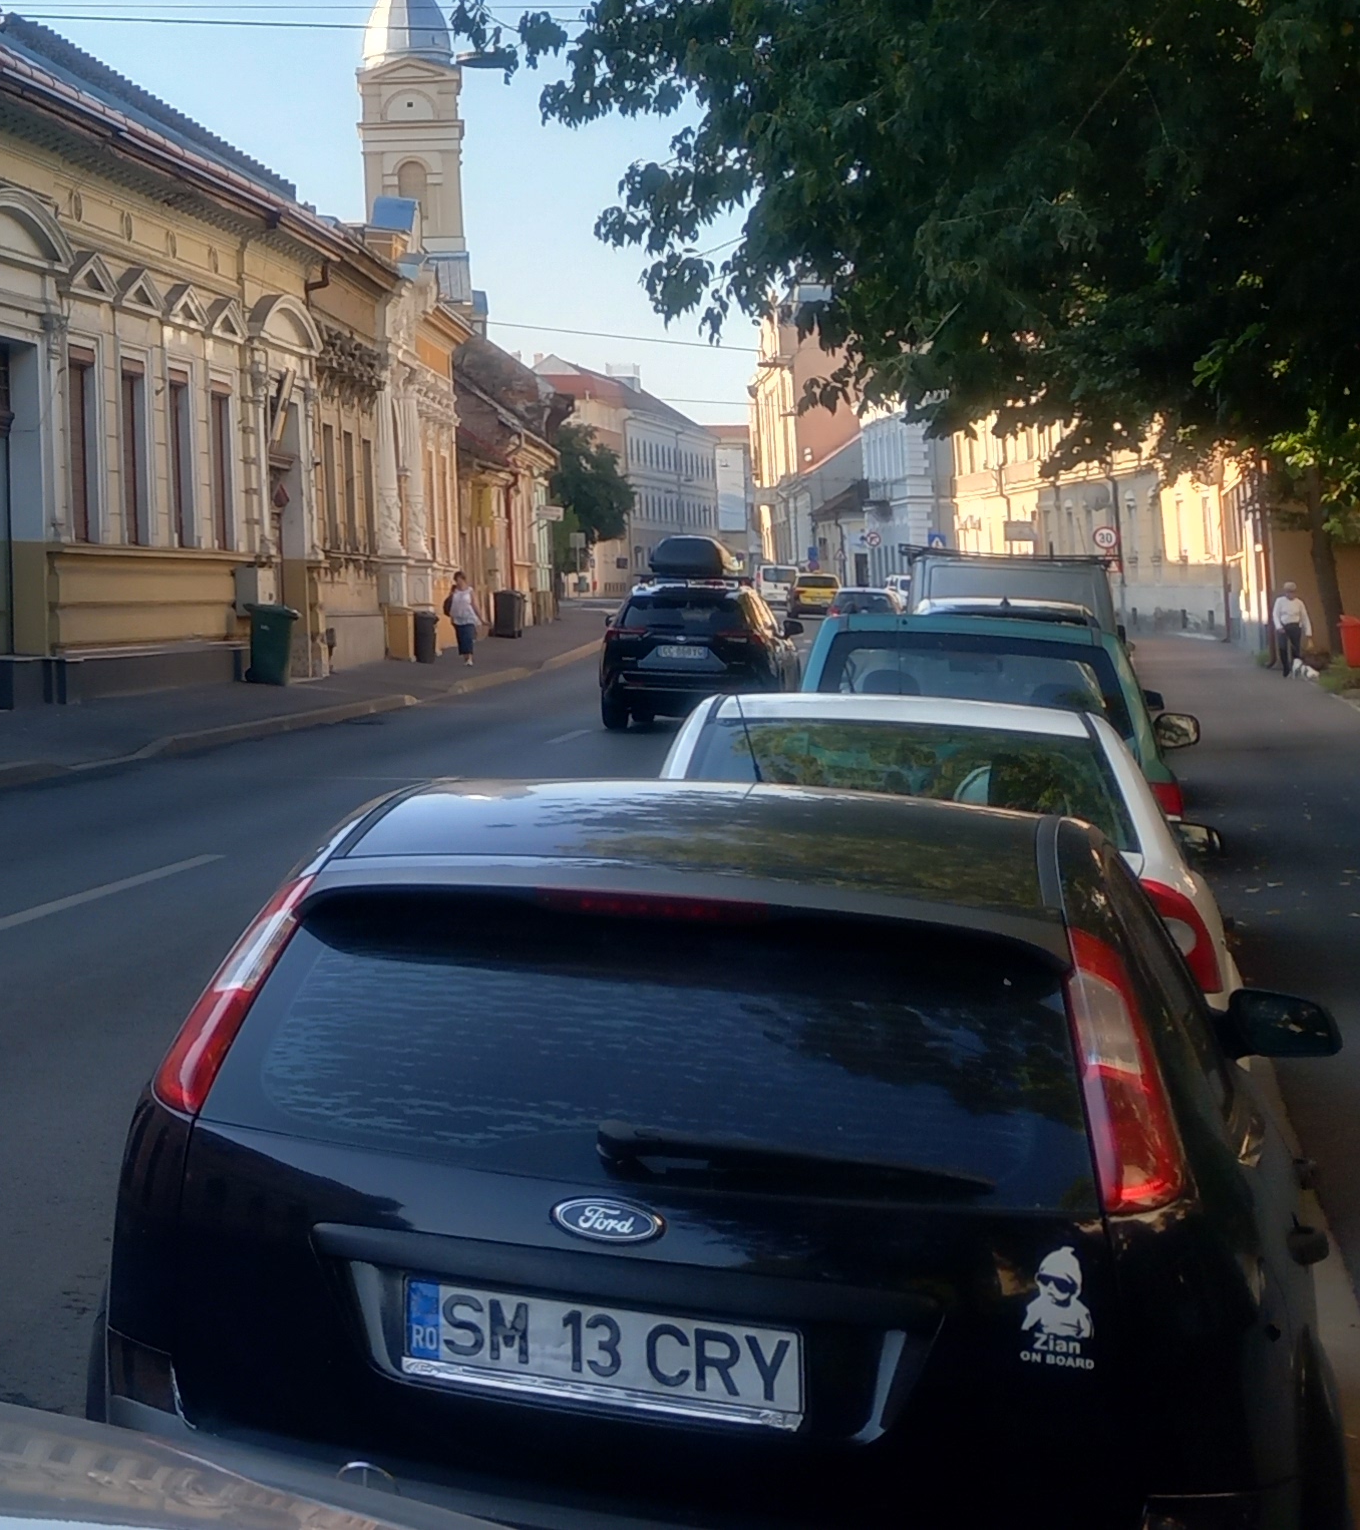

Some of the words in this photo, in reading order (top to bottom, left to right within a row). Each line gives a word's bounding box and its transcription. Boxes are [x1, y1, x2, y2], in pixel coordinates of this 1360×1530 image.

[1098, 532, 1113, 544] 30
[578, 1205, 634, 1235] Ford
[412, 1323, 437, 1351] RO
[442, 1294, 529, 1365] SM
[562, 1309, 622, 1378] 13
[645, 1323, 791, 1402] CRY
[1033, 1332, 1081, 1355] Zian
[1020, 1350, 1041, 1363] ON
[1046, 1354, 1094, 1370] BOARD
